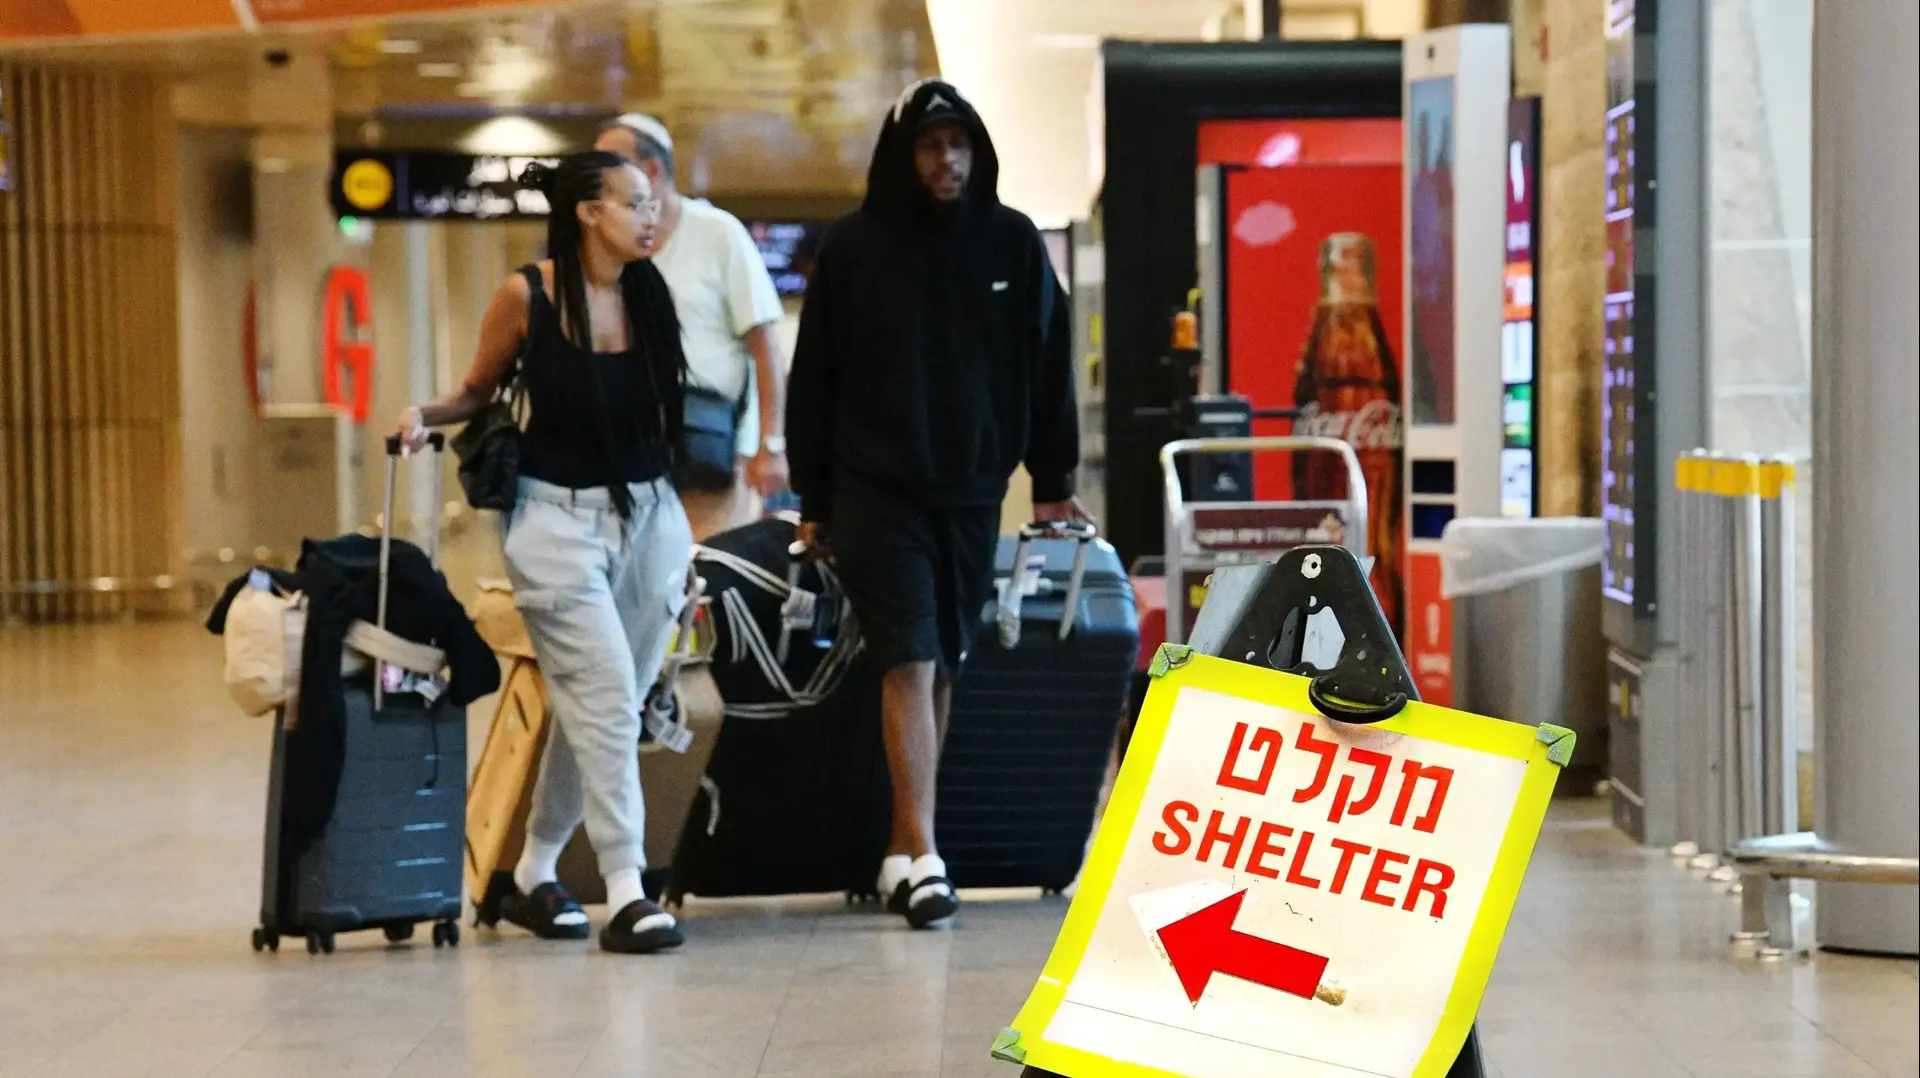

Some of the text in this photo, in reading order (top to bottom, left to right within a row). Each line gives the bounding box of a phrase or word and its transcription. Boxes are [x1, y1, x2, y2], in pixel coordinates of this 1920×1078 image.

[1293, 399, 1404, 449] Coca-Col
[1217, 722, 1454, 833] מקלט
[1153, 801, 1454, 918] SHELTER
